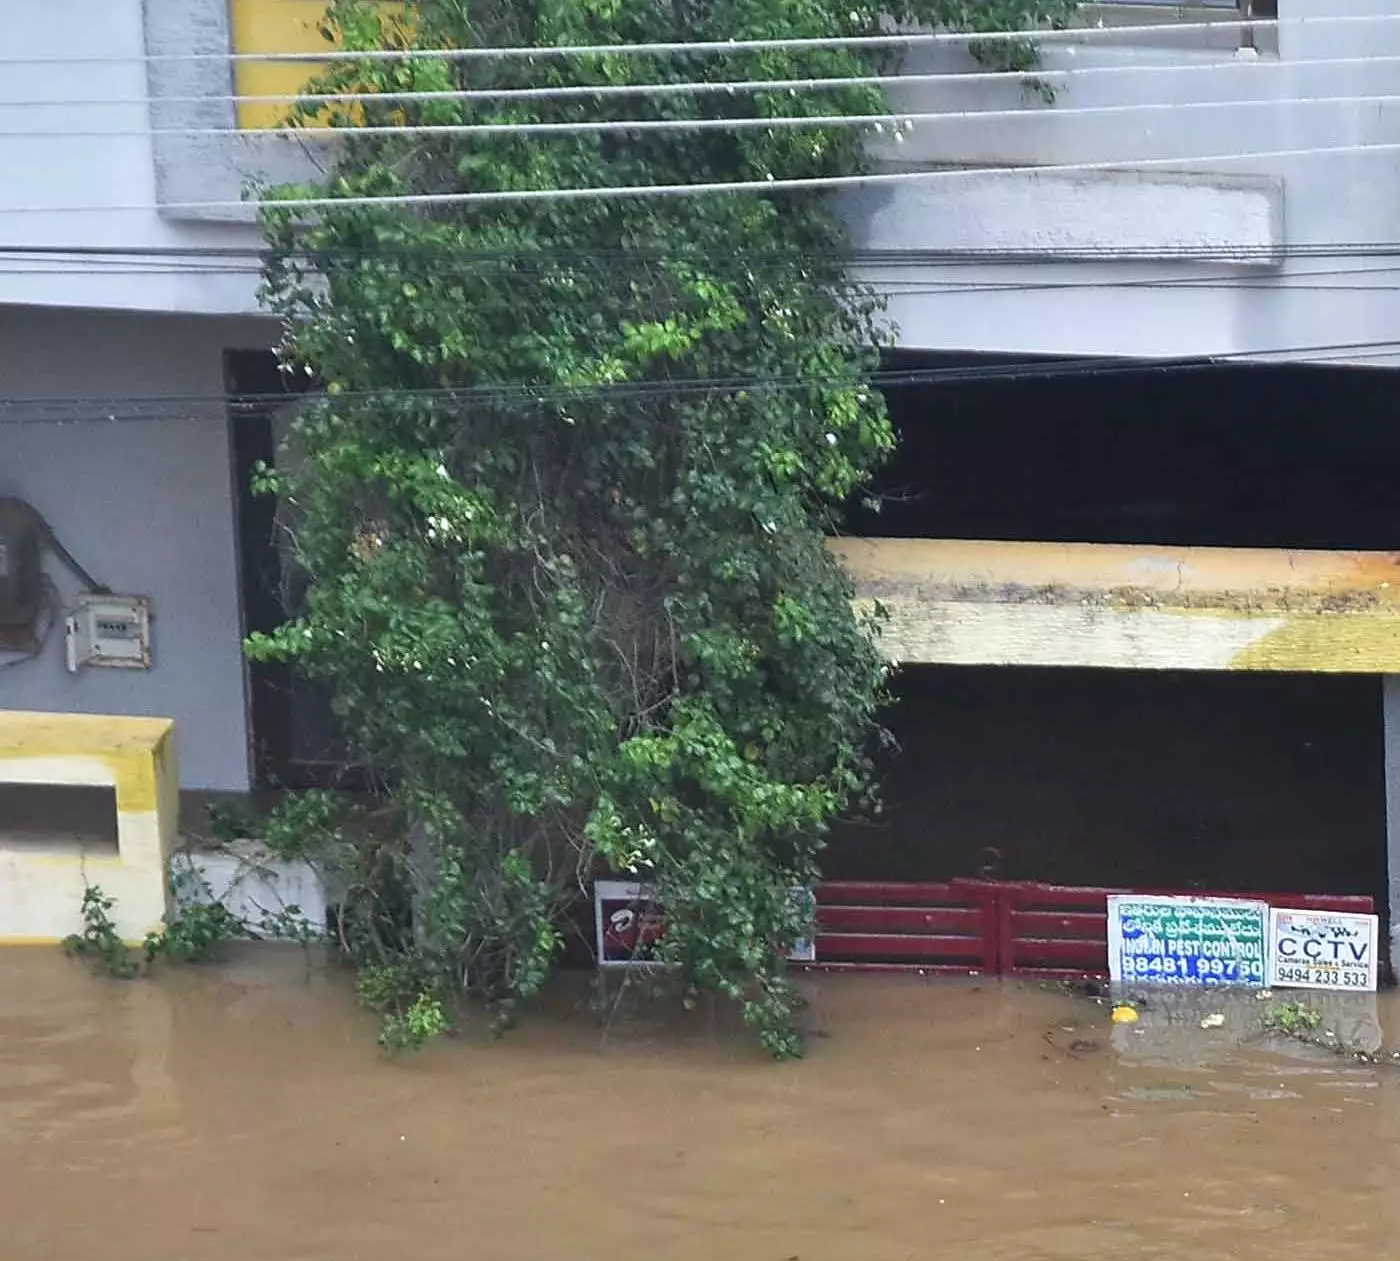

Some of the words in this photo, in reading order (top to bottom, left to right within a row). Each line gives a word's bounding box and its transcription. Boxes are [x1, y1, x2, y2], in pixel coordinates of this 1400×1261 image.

[1168, 939, 1200, 957] PEST
[1203, 940, 1261, 959] CONTROL
[1278, 938, 1368, 960] CCTV
[1341, 960, 1369, 968] Service
[1278, 967, 1310, 981] 9494
[1315, 970, 1338, 984] 233
[1343, 972, 1367, 986] 533
